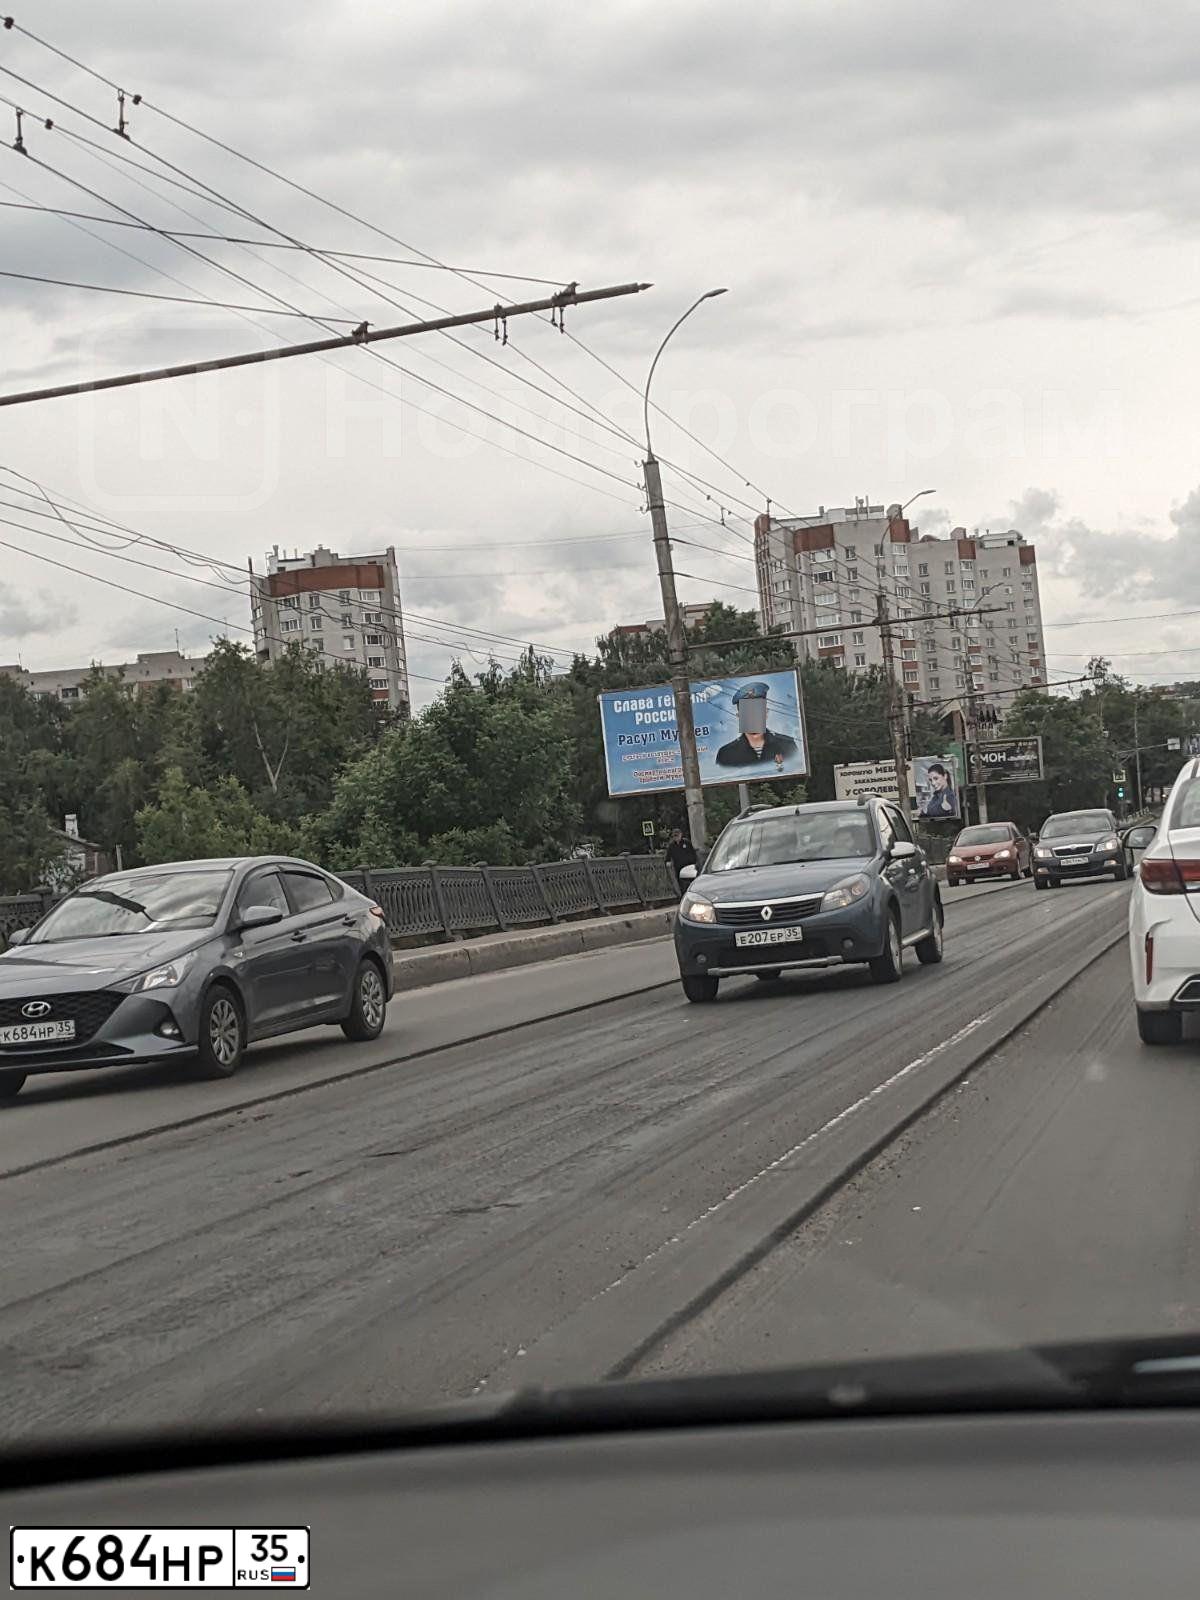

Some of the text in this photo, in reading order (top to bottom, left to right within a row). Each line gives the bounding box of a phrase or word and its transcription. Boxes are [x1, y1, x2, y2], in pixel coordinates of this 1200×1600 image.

[613, 697, 654, 713] Слава
[618, 726, 710, 746] Расул Муев
[740, 928, 798, 945] Е207ЕР 35
[3, 1020, 71, 1041] К684НР 35
